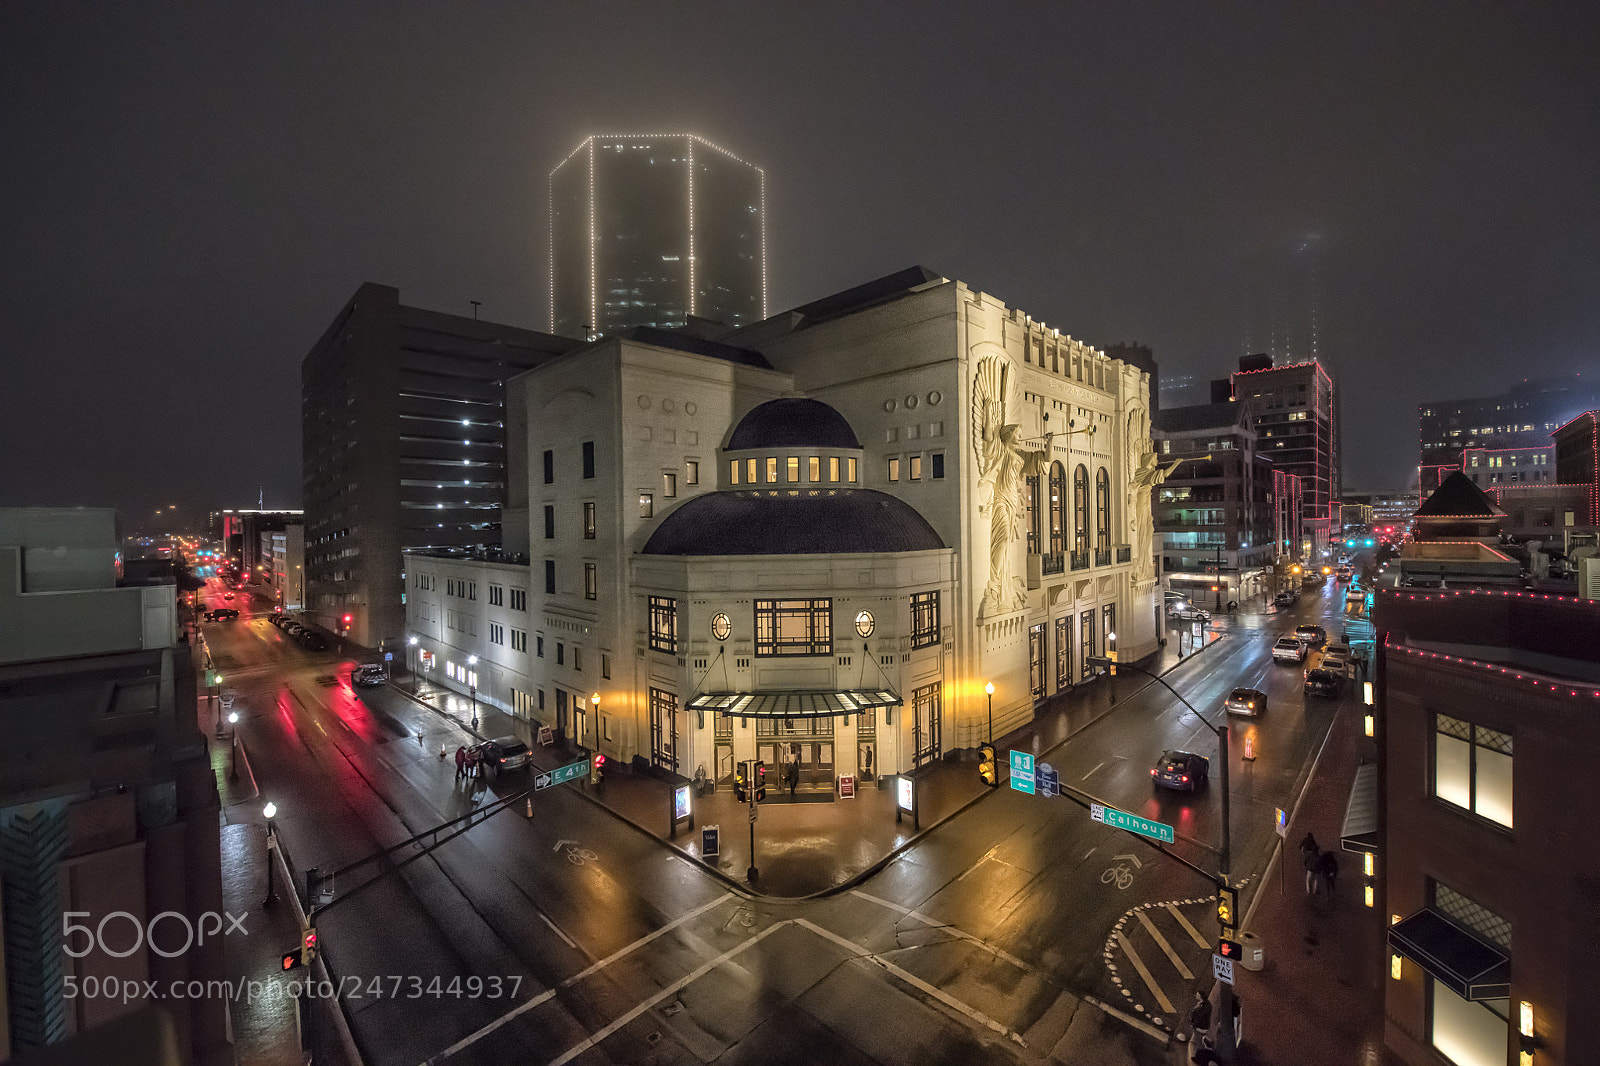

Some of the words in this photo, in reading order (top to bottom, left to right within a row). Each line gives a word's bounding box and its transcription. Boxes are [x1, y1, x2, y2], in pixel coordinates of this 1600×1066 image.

[554, 771, 561, 779] E
[1108, 812, 1167, 836] Calhoun
[1215, 957, 1231, 967] ONE
[1215, 964, 1231, 974] WAY
